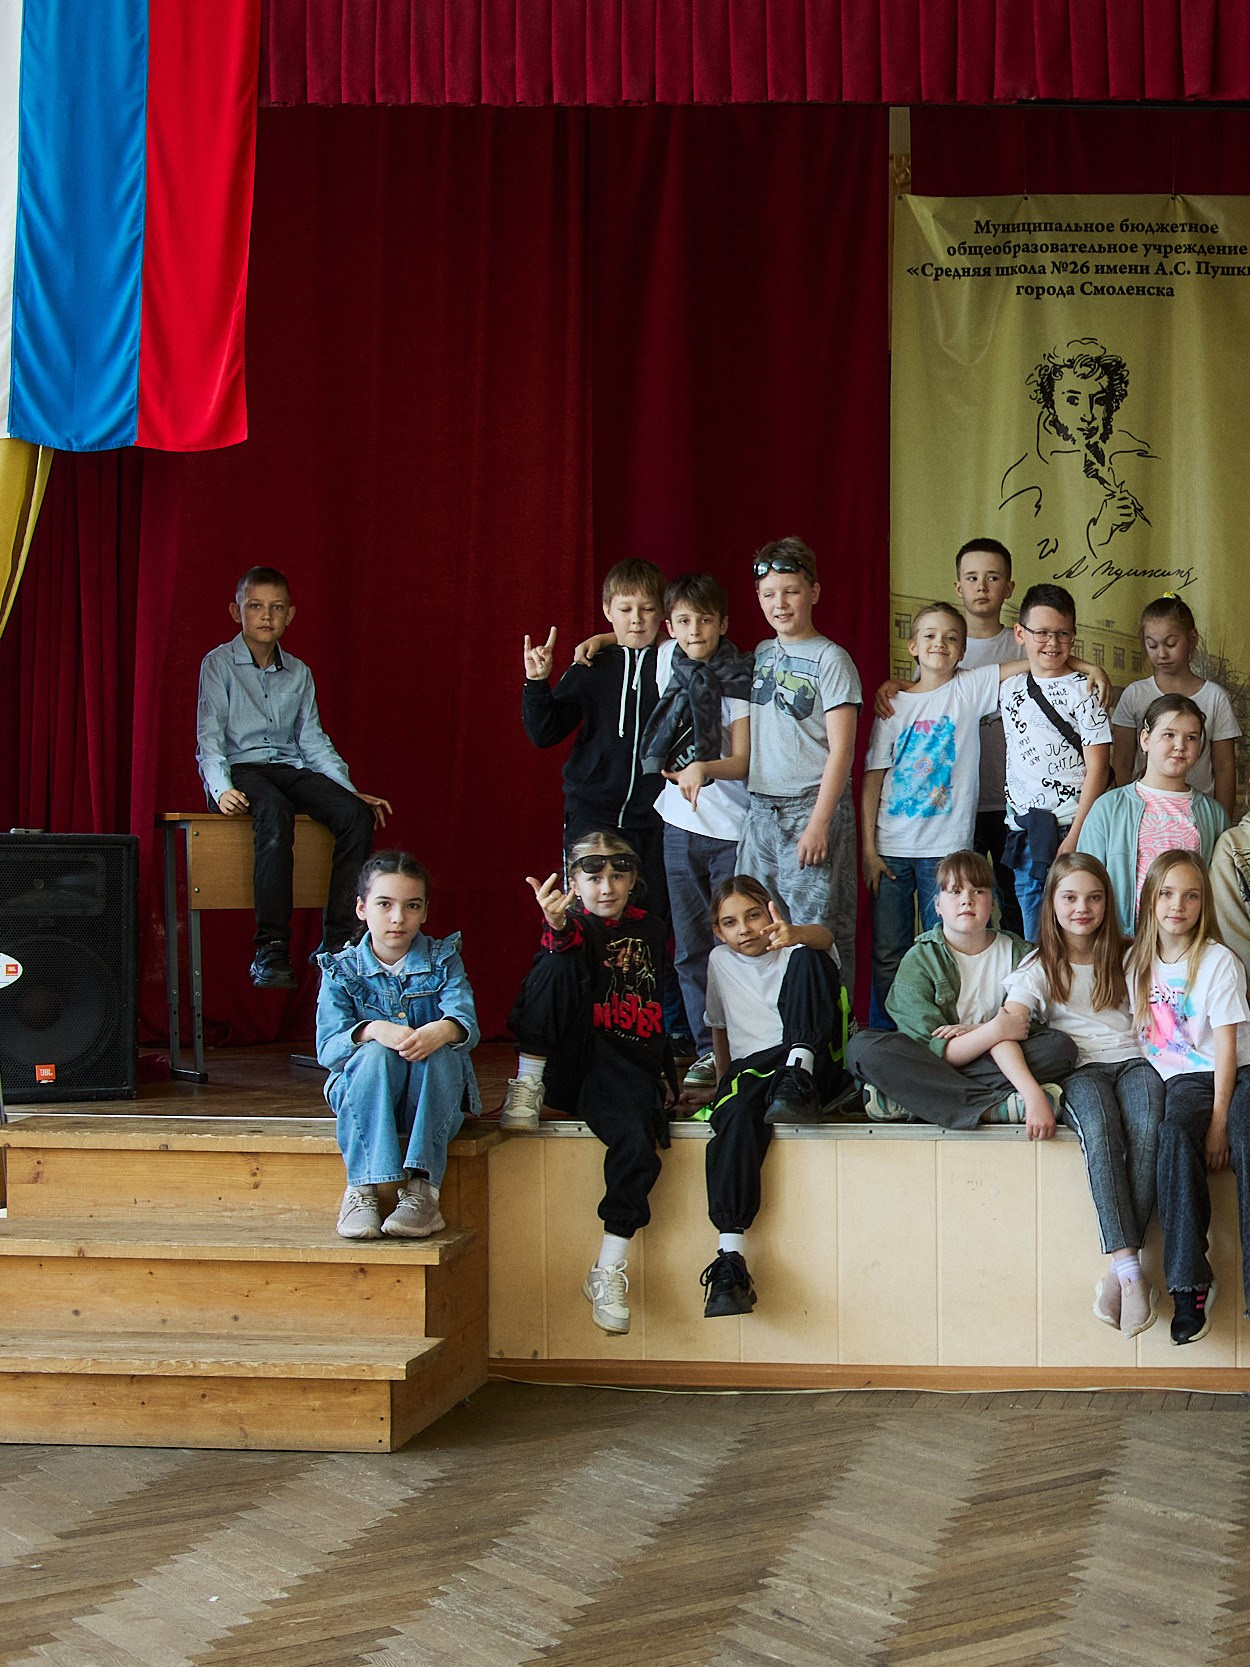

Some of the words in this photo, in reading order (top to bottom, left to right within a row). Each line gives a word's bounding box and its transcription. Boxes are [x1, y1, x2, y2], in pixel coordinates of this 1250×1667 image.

[973, 219, 1115, 237] Муниципальное
[1119, 218, 1219, 235] бюджетное
[946, 240, 1139, 258] общеобразовательное
[1142, 242, 1248, 258] учреждение
[906, 262, 991, 281] «Средняя
[995, 263, 1047, 277] школа
[1050, 260, 1090, 275] №26
[1094, 263, 1150, 275] имени
[1153, 261, 1191, 276] А.С.
[1015, 283, 1075, 300] города
[1079, 281, 1175, 297] Смоленска
[1044, 738, 1071, 757] JUS
[593, 992, 663, 1039] MASTER
[40, 1068, 53, 1077] JBL
